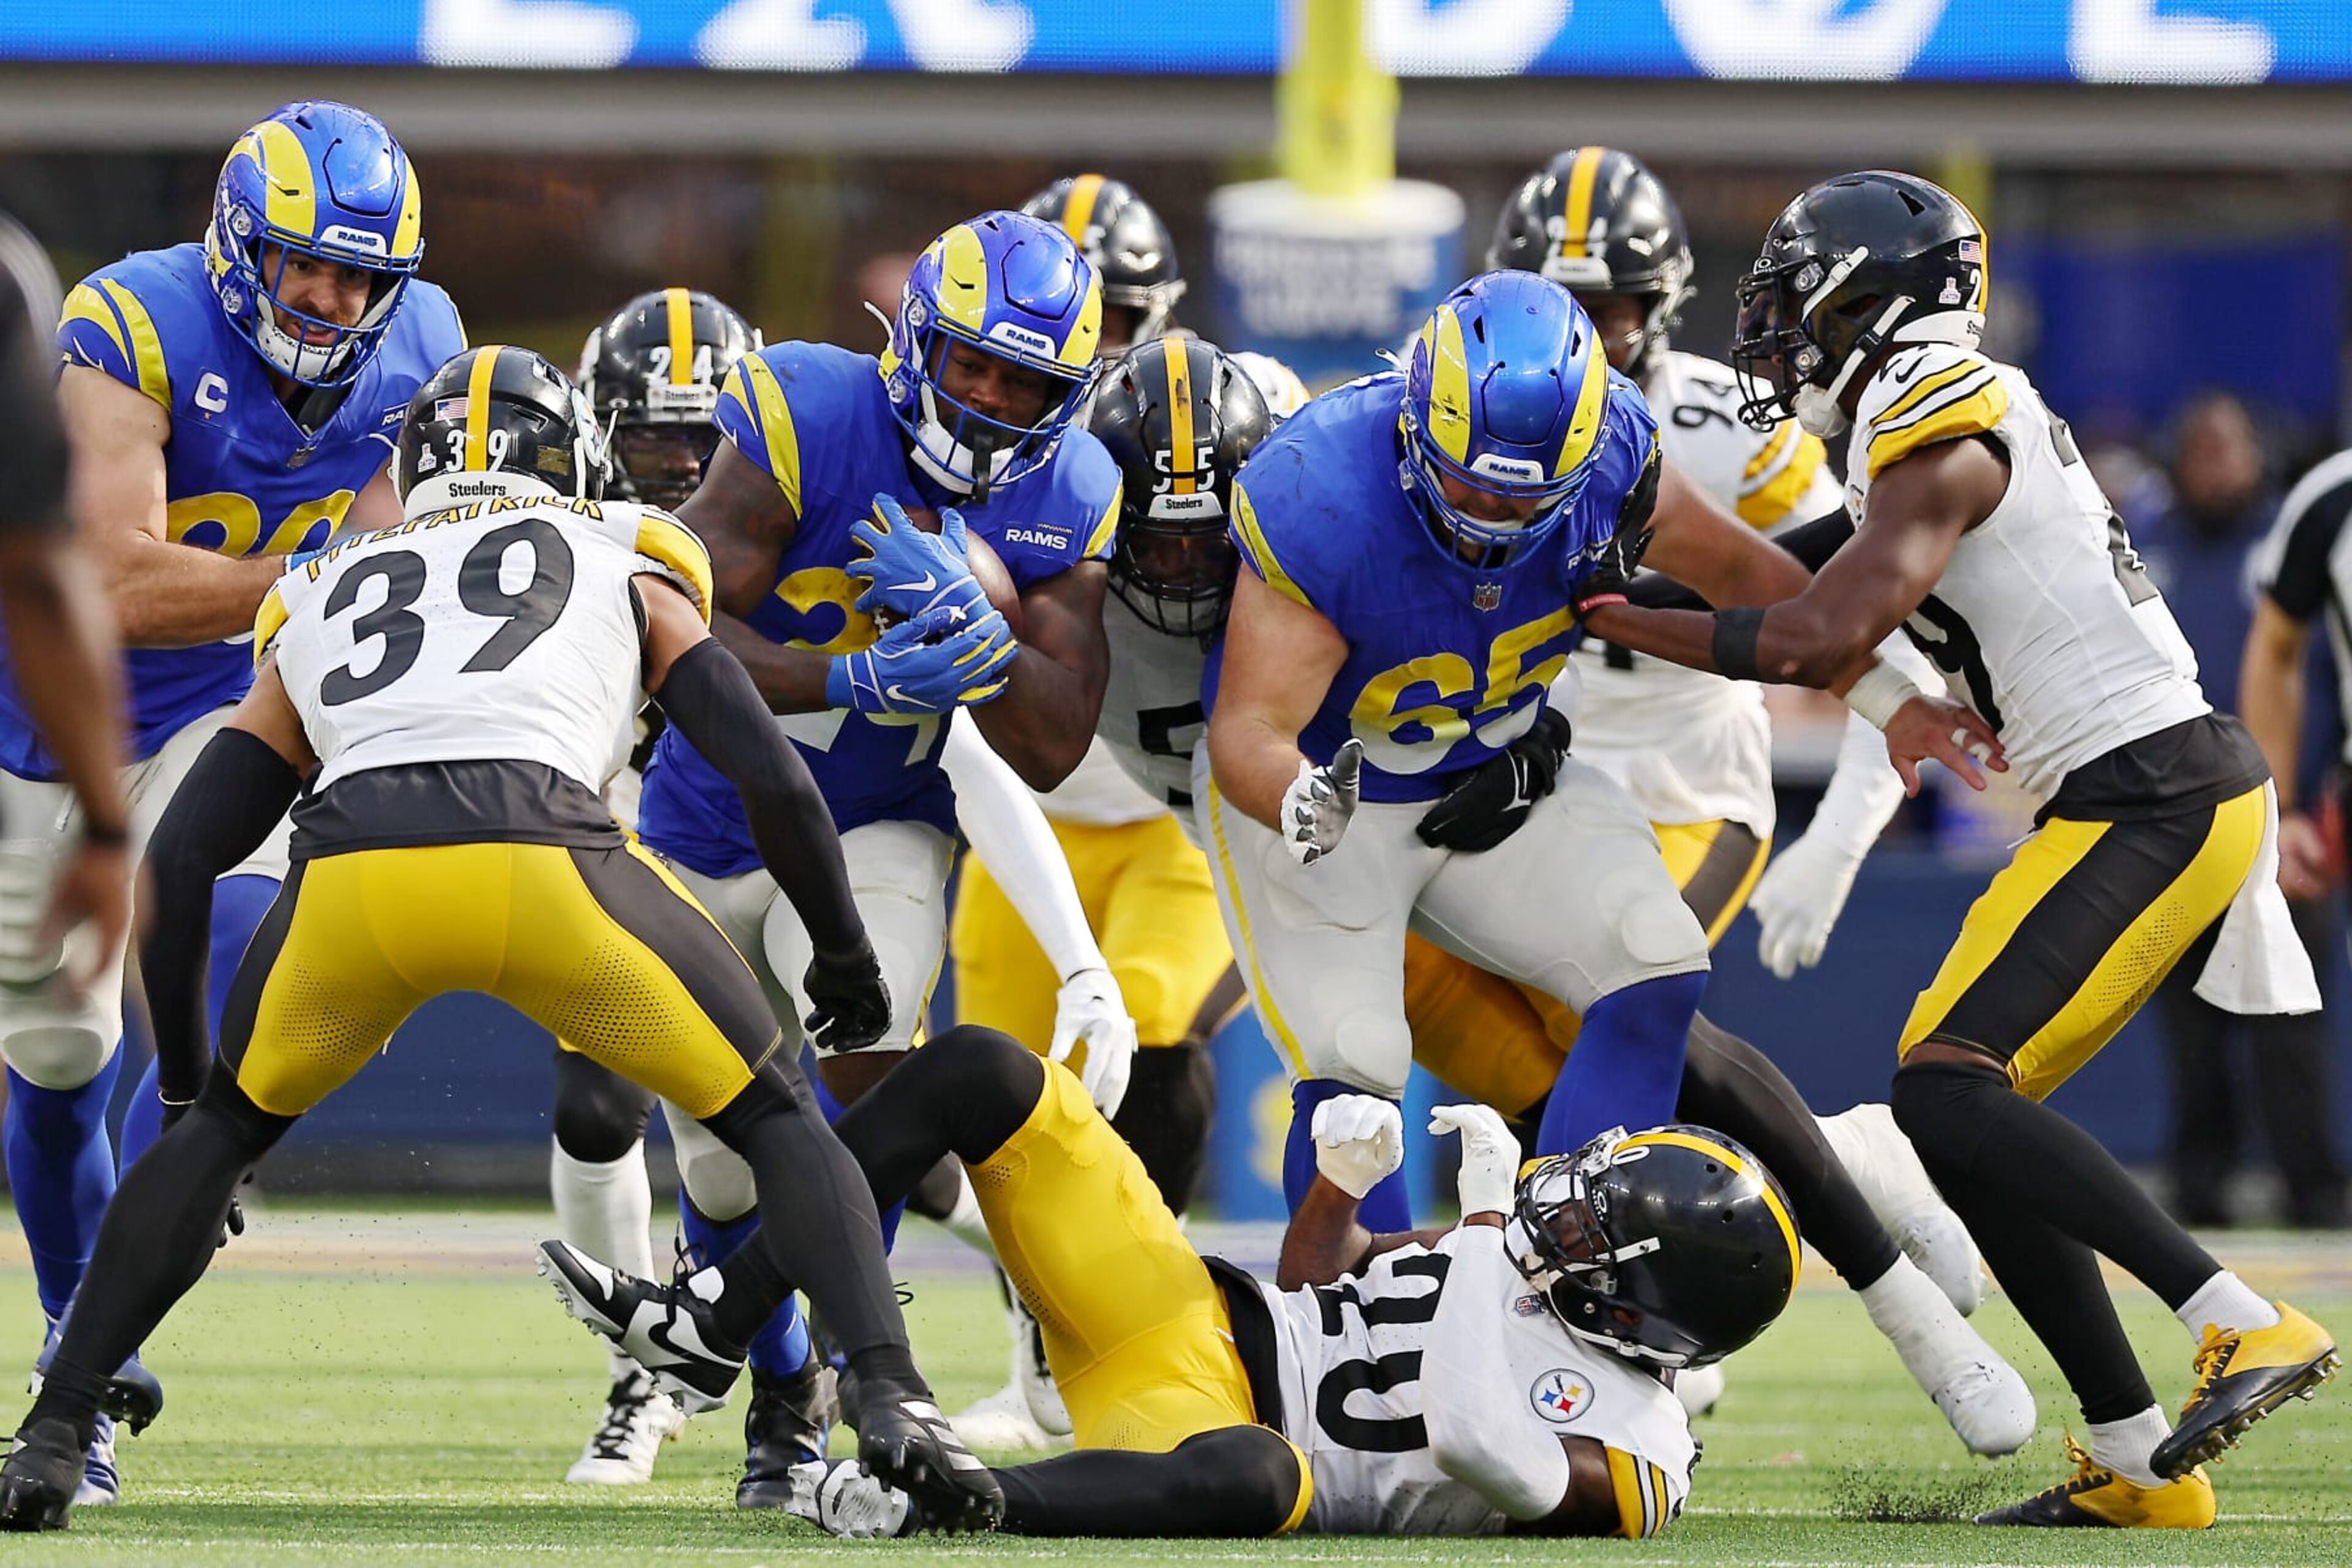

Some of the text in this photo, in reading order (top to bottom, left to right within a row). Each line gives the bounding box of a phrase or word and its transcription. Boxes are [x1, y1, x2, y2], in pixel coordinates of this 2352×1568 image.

[337, 231, 377, 246] RAMS
[1006, 330, 1046, 350] RAMS
[649, 345, 714, 385] 24
[195, 372, 228, 413] C
[445, 429, 508, 472] 39
[1152, 447, 1215, 493] 55
[448, 481, 507, 497] Steelers
[1166, 498, 1203, 510] Steelers
[1005, 529, 1068, 550] RAMS
[320, 518, 575, 706] 39
[1348, 605, 1576, 775] 65
